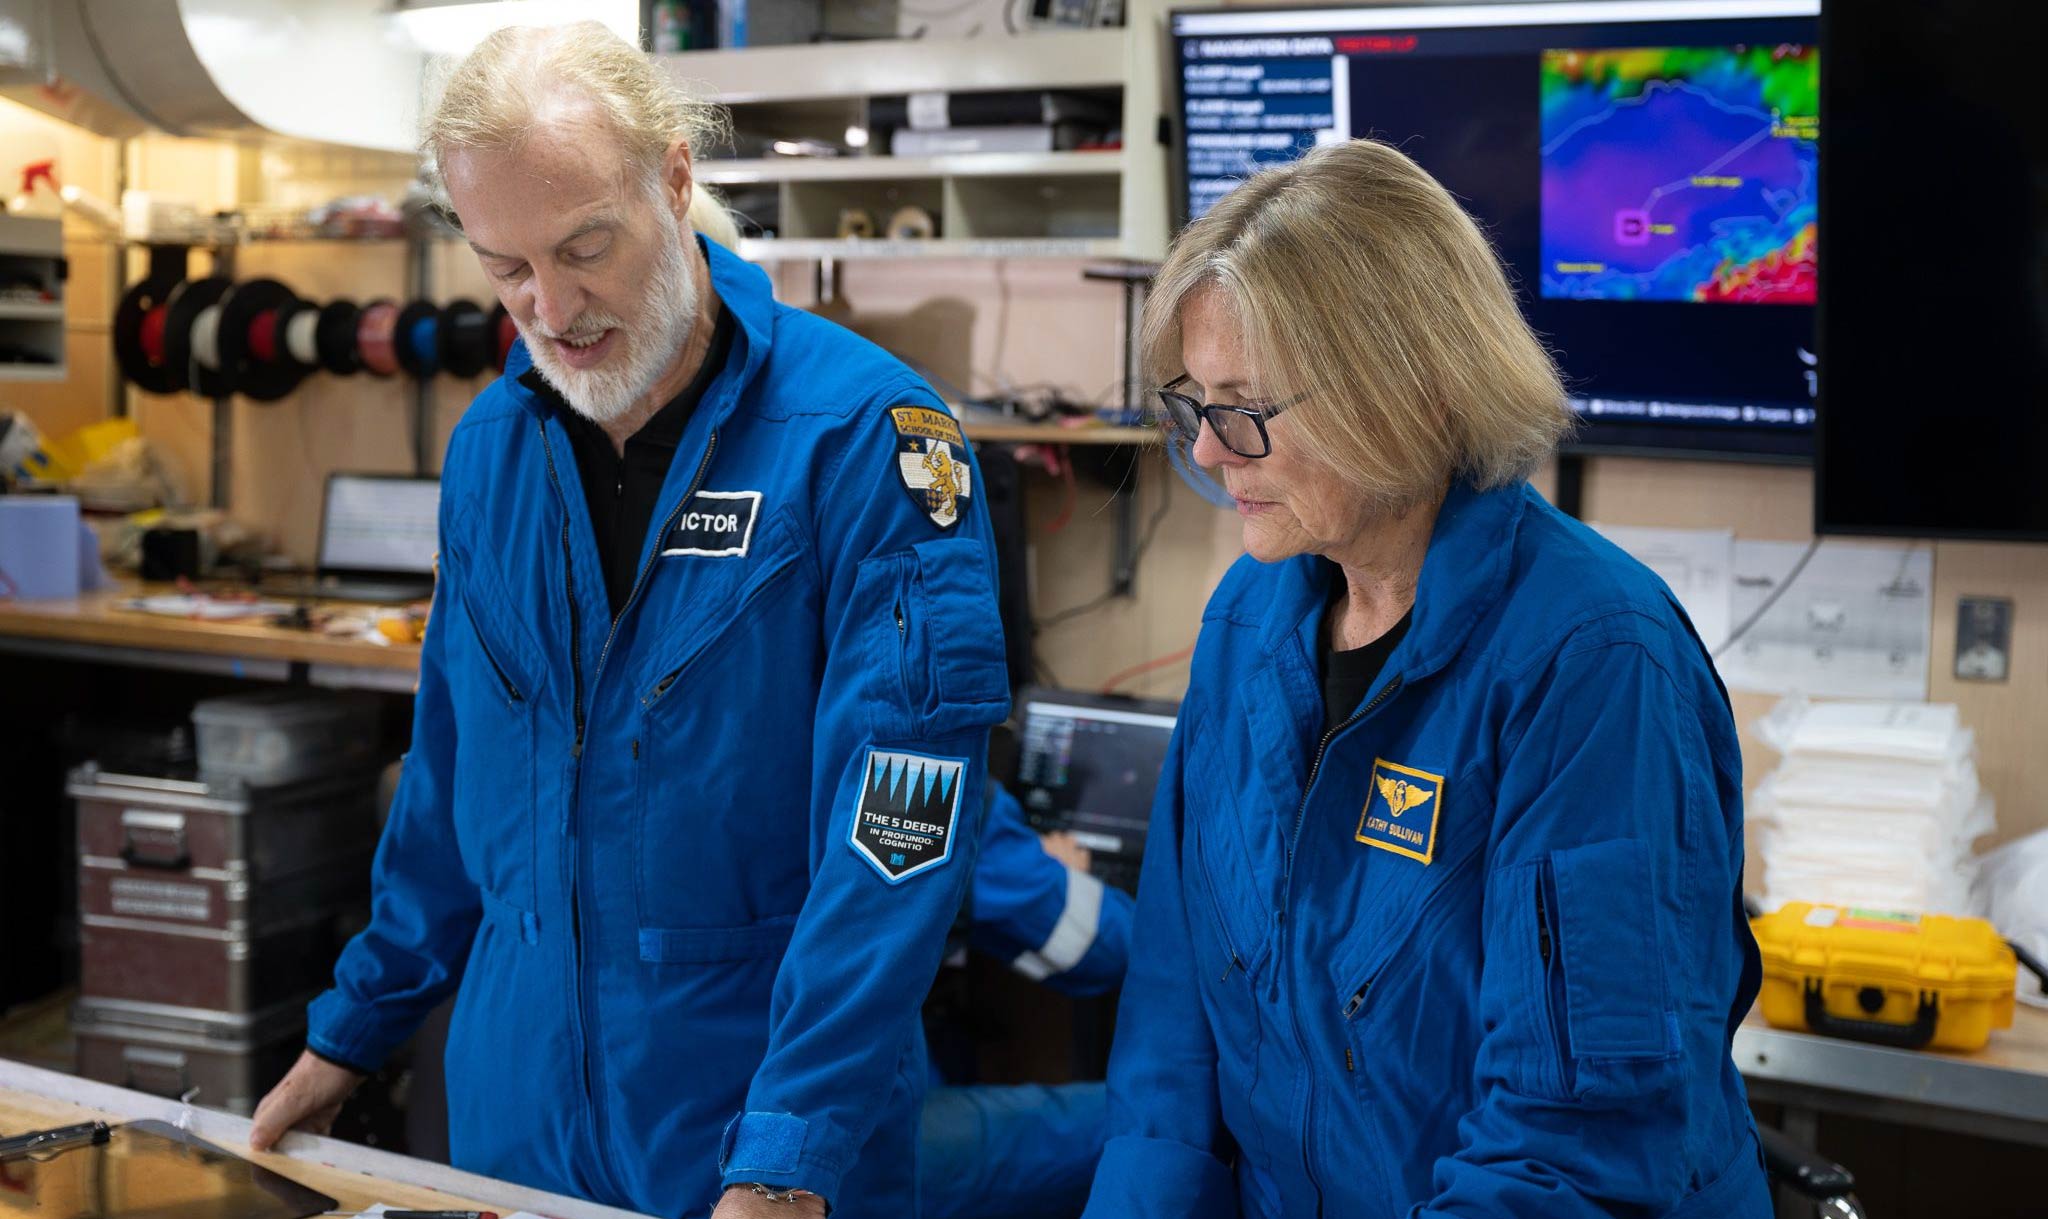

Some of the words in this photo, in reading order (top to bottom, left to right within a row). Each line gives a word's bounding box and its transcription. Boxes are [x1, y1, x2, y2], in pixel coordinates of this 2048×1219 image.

[896, 411, 917, 423] ST.
[675, 512, 738, 532] ICTOR
[864, 812, 890, 826] THE
[891, 817, 901, 828] 5
[902, 820, 945, 836] DEEPS
[1366, 816, 1388, 832] KATHY
[1389, 823, 1423, 845] SULLIVAN
[869, 827, 880, 836] IN
[881, 830, 934, 846] PROFUNDO:
[879, 837, 922, 851] COGNITIO
